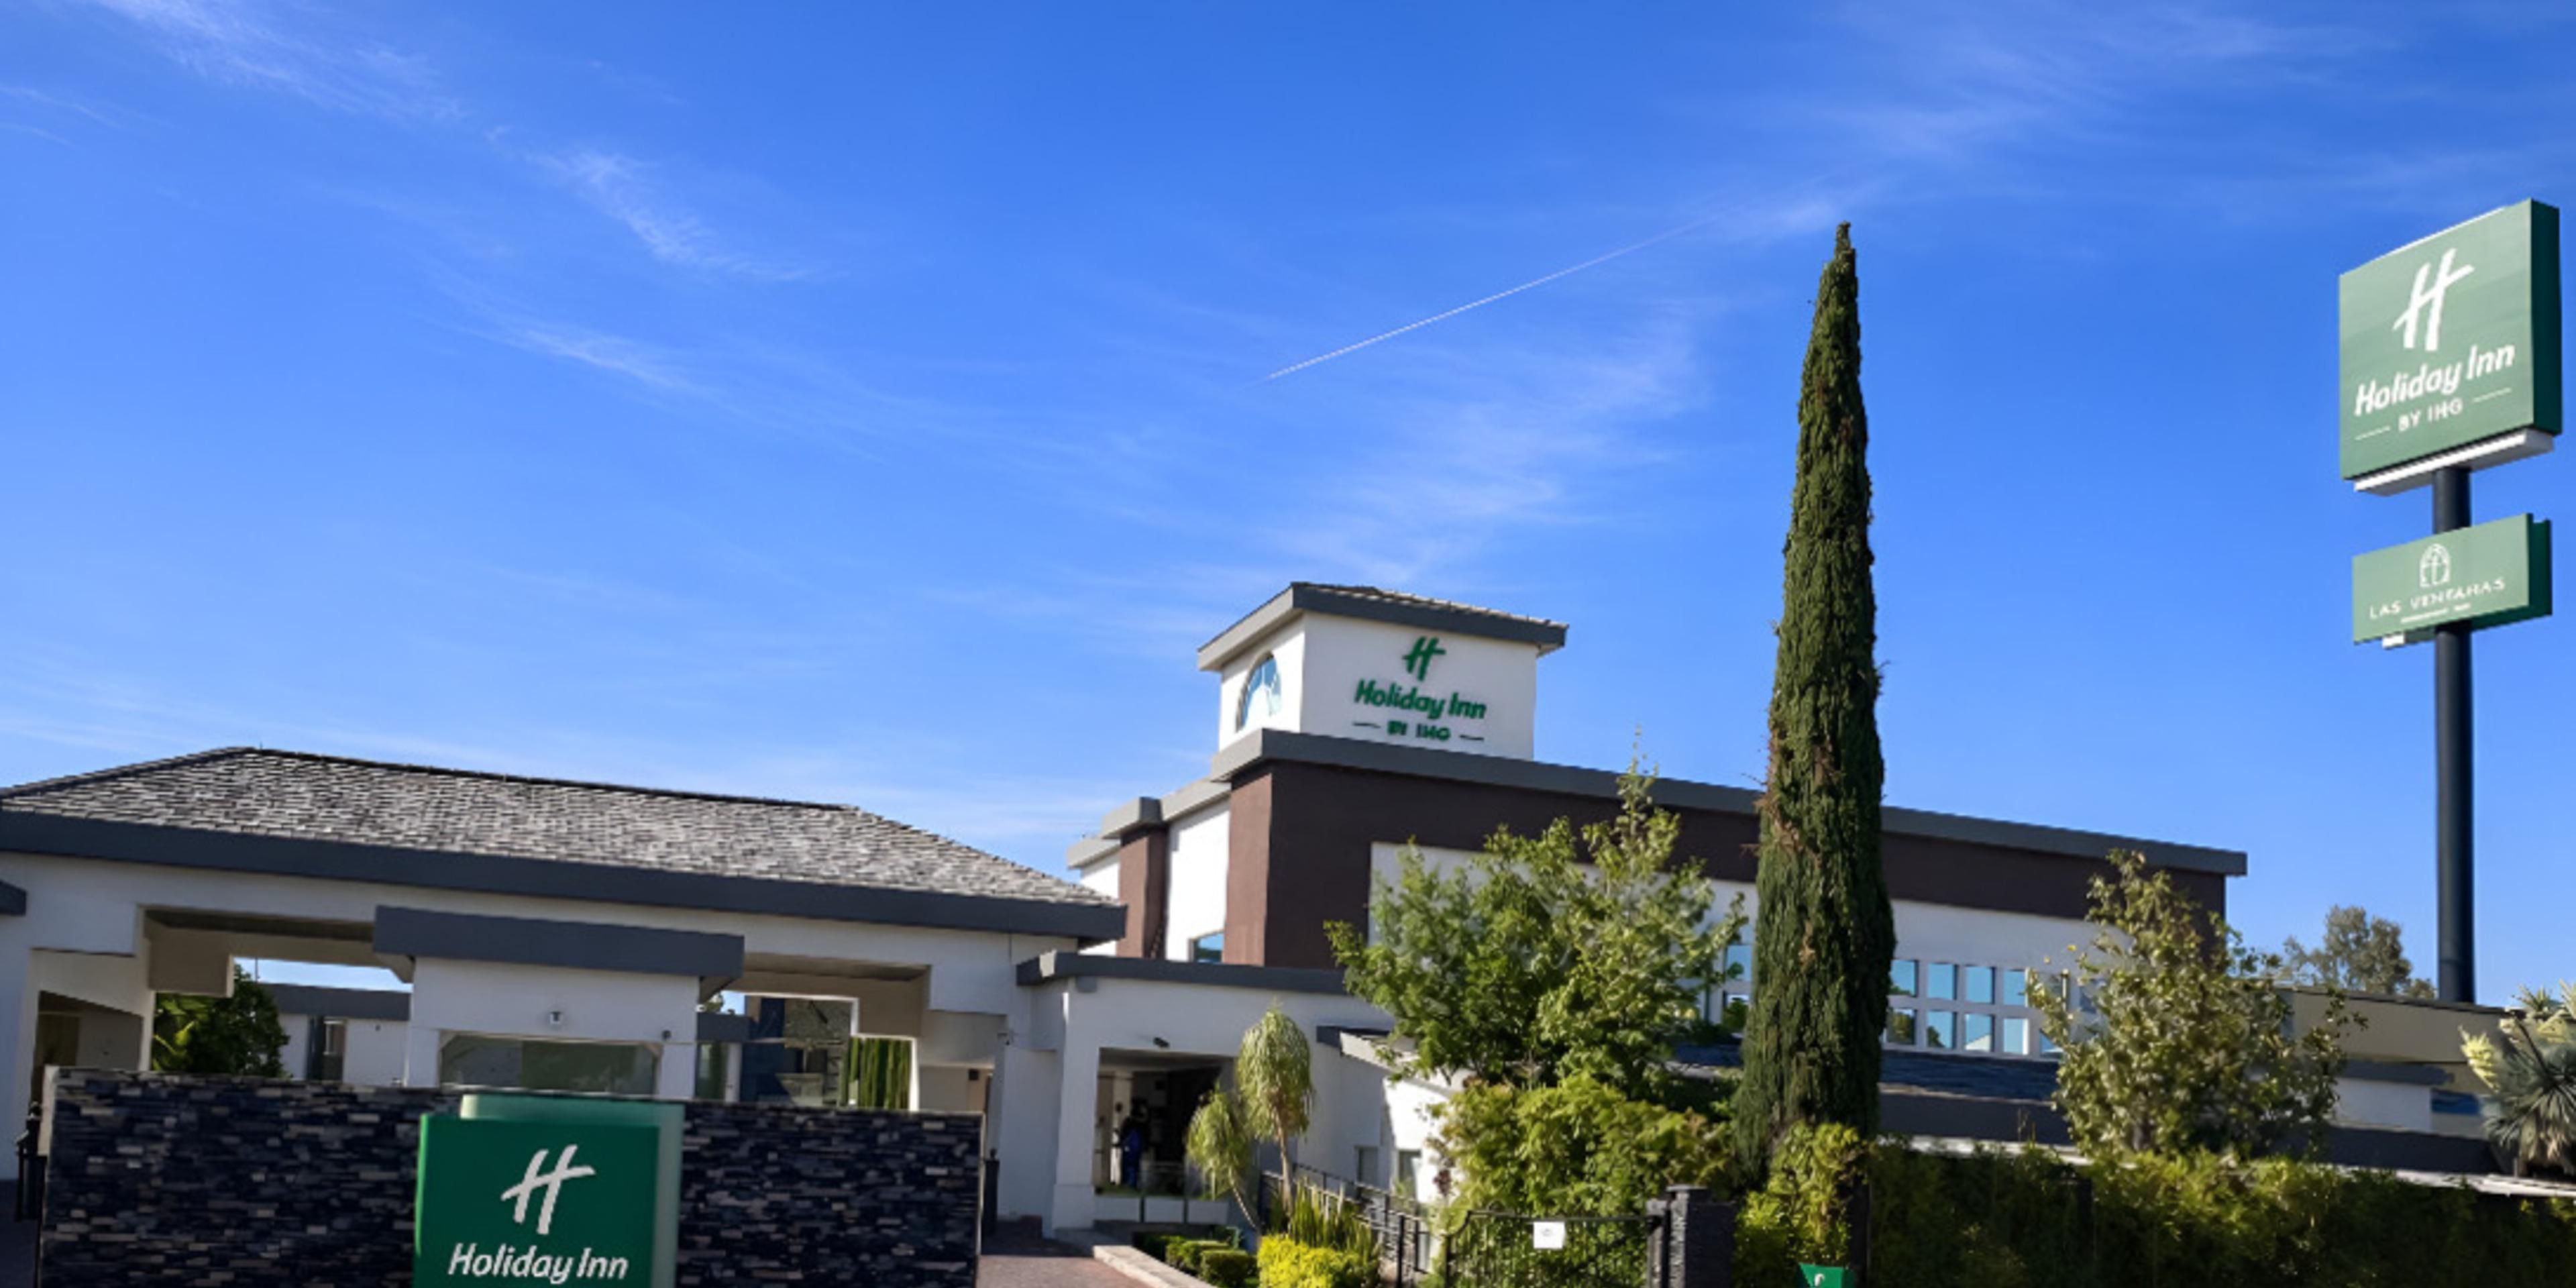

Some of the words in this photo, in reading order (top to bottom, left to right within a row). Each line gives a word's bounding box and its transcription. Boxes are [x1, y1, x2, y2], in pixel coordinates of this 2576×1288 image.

[2354, 362, 2461, 417] Holiday
[2467, 345, 2515, 380] Inn
[2398, 411, 2420, 432] BY
[2369, 600, 2402, 620] LAS
[1354, 679, 1446, 720] Holiday
[1448, 692, 1487, 720] Inn
[448, 1242, 574, 1285] Holiday
[576, 1247, 629, 1279] Inn
